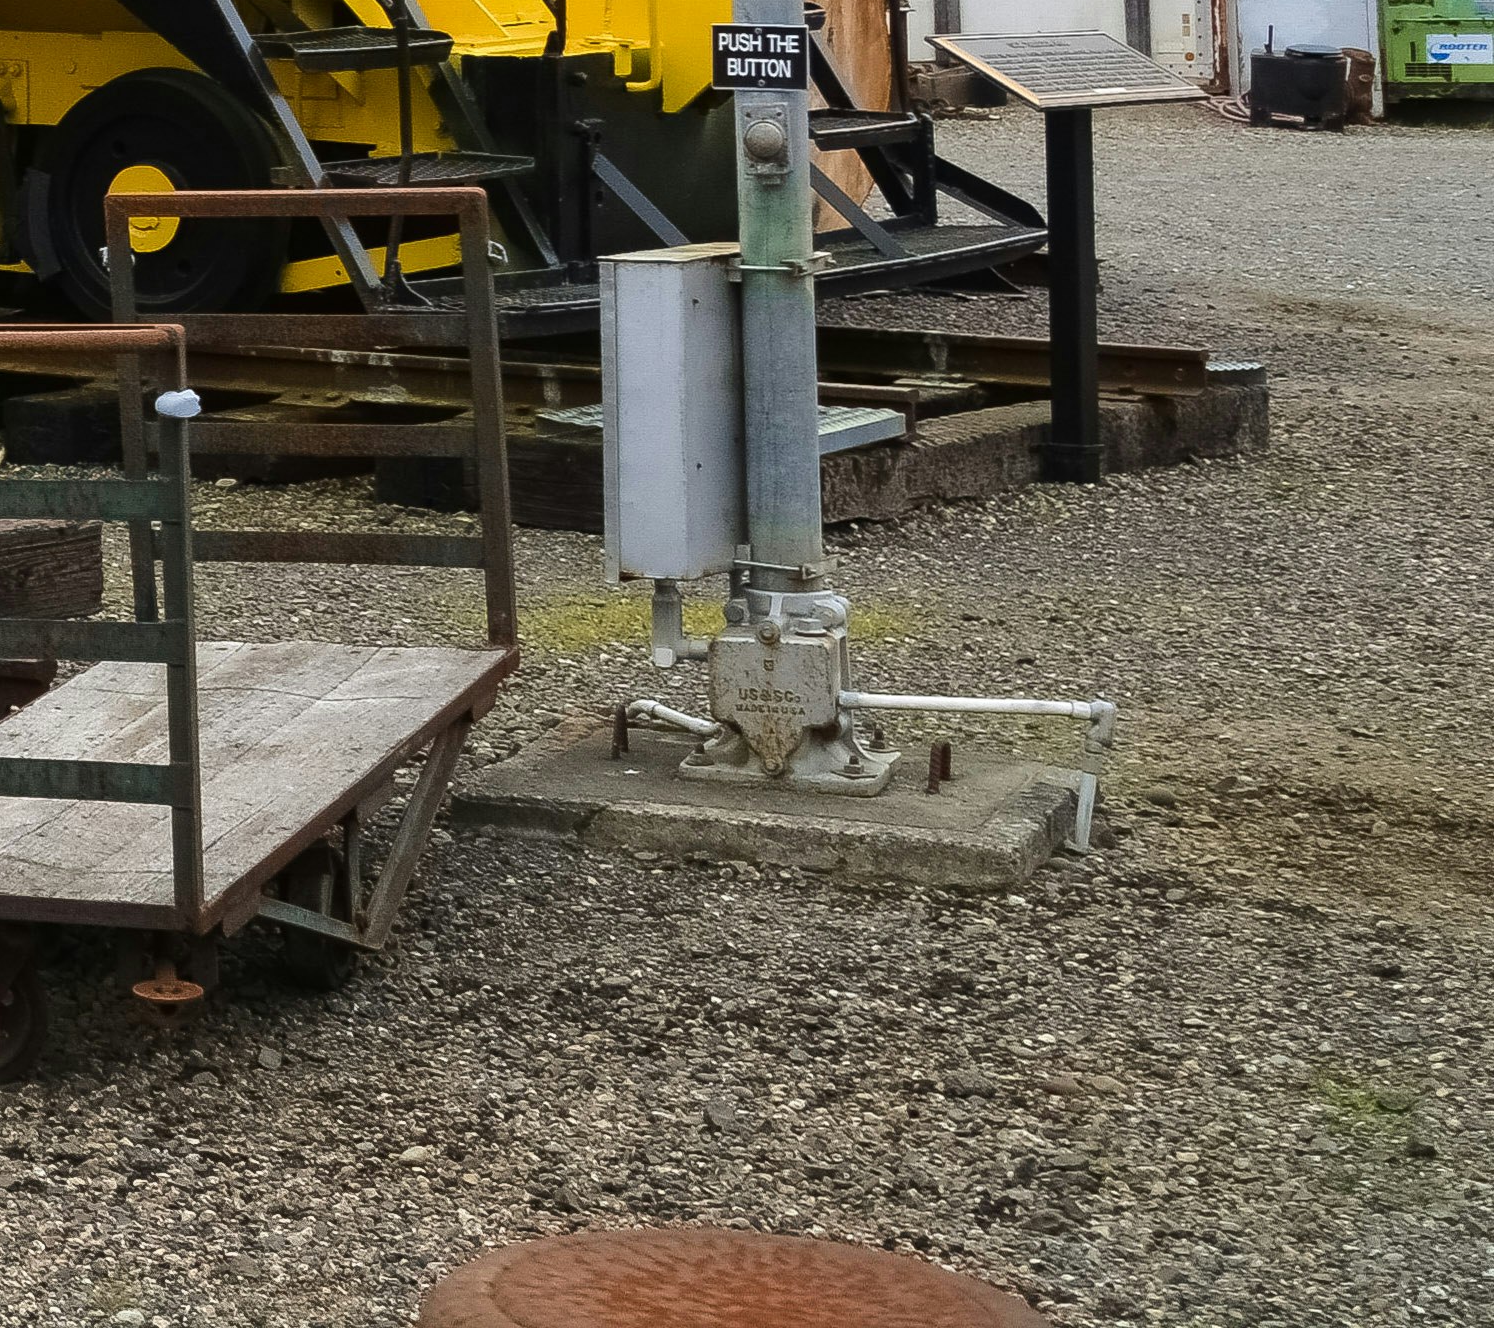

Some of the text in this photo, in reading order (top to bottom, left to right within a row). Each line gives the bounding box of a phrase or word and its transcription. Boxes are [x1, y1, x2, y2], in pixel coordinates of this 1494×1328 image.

[718, 32, 800, 53] PUSH THE
[727, 58, 792, 78] BUTTON
